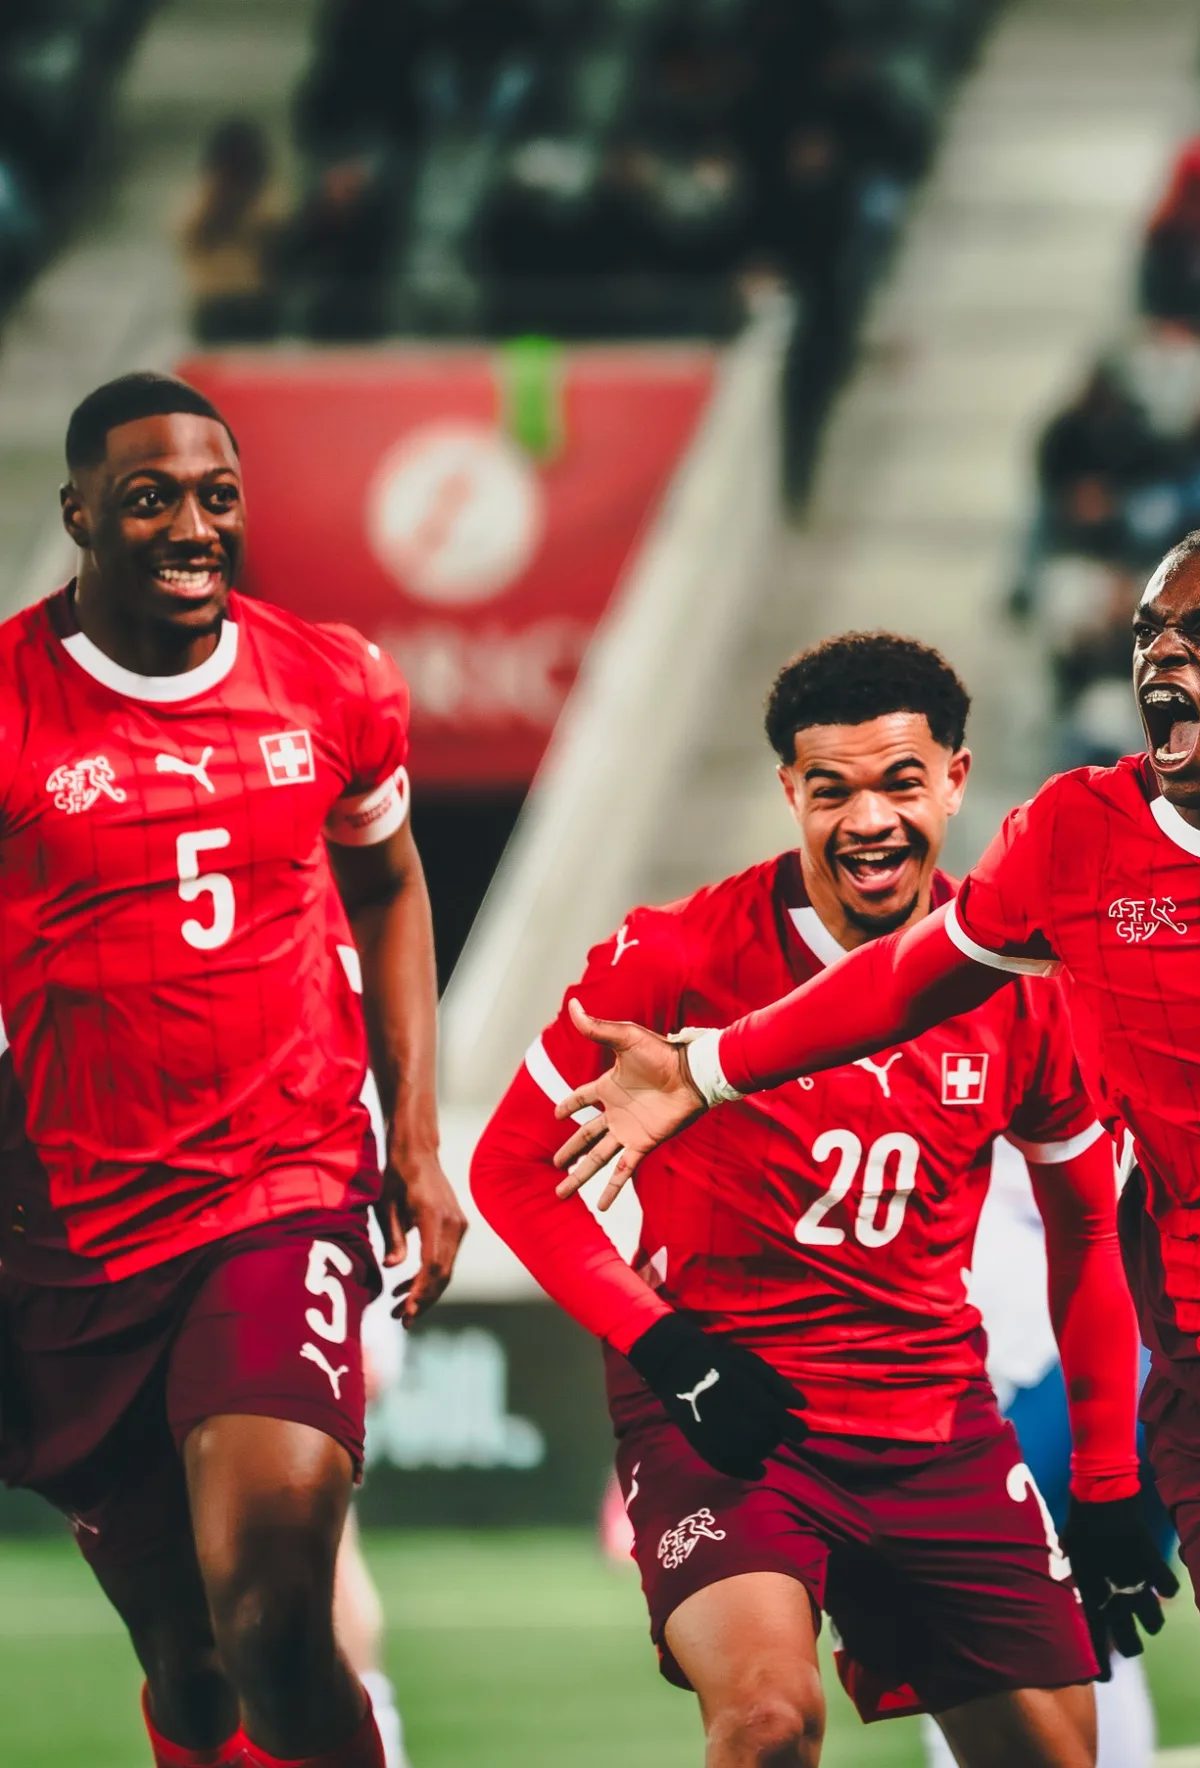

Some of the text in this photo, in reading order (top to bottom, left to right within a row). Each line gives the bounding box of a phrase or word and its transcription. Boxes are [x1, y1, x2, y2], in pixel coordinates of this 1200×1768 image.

[176, 827, 235, 950] 5
[794, 1129, 920, 1248] 20
[305, 1239, 353, 1344] 5
